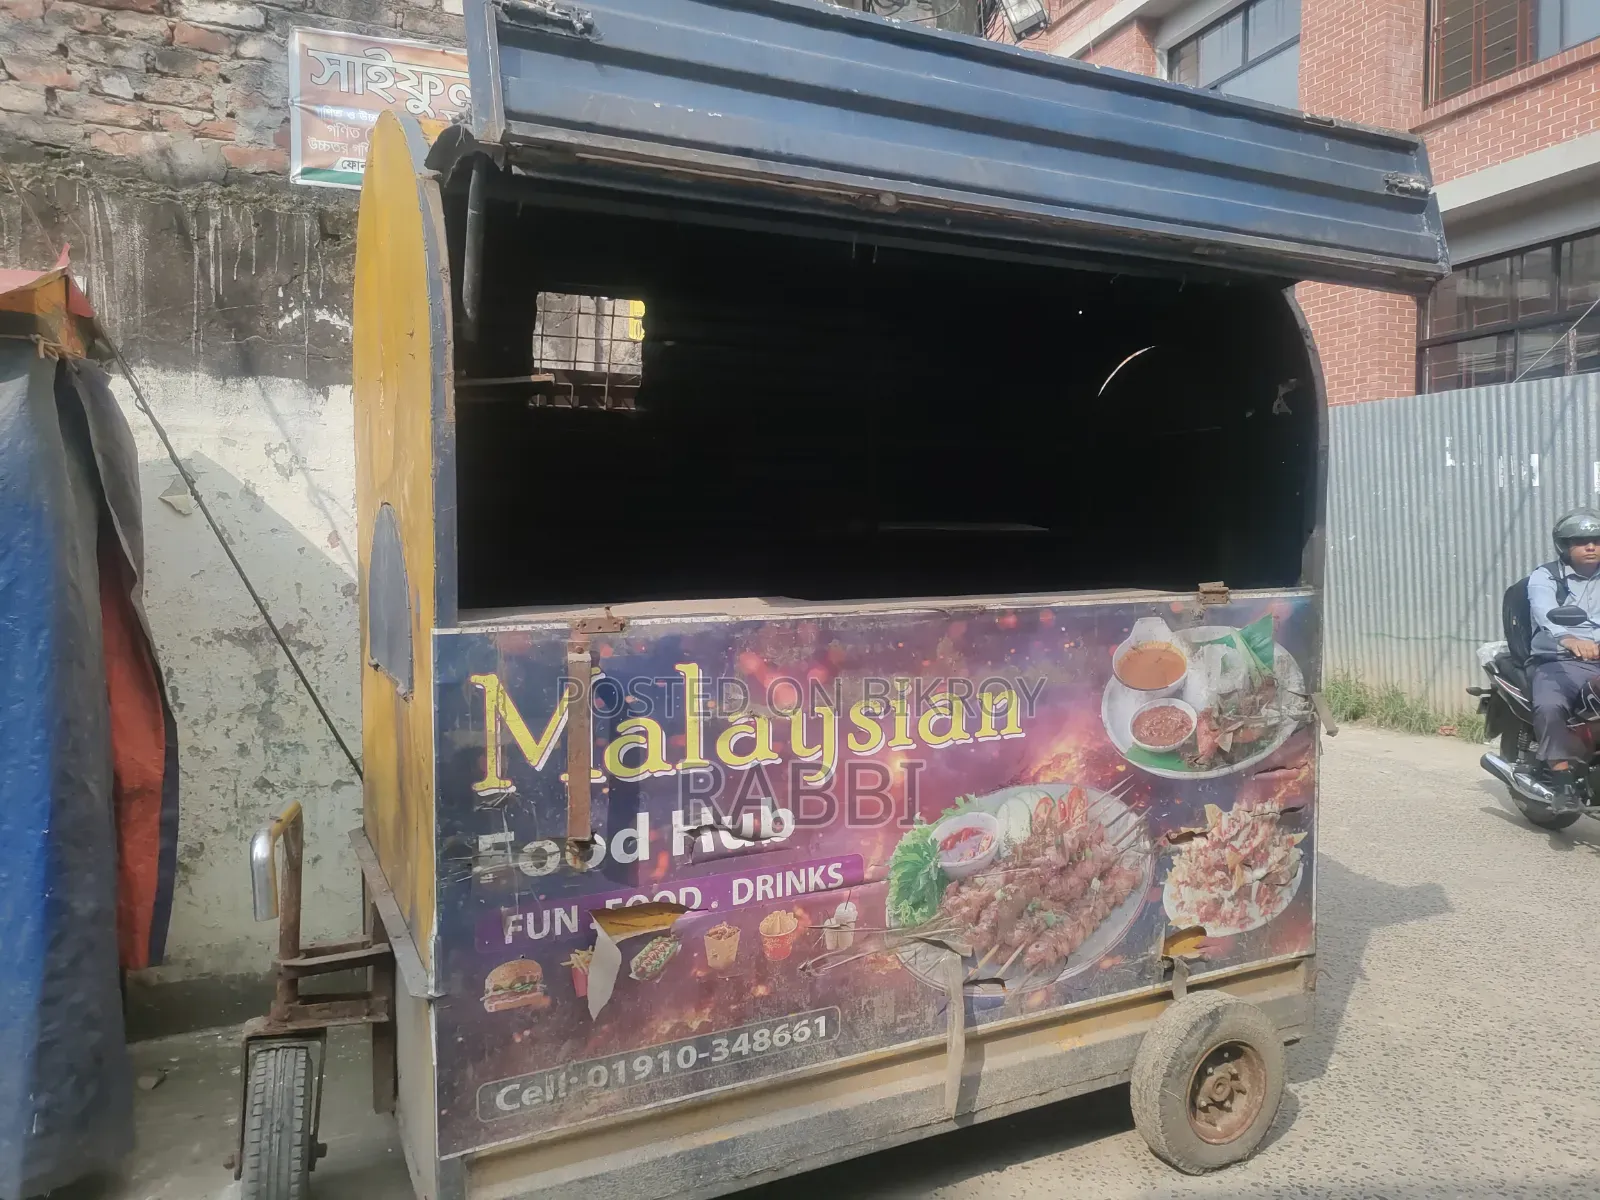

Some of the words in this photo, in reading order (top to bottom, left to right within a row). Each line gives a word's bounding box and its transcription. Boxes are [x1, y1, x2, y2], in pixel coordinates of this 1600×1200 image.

[307, 136, 349, 156] উচ্চতর
[326, 122, 361, 139] গণিত
[470, 662, 1025, 796] Malaysian
[477, 812, 650, 884] Food
[671, 797, 795, 856] Hub
[503, 905, 579, 944] FUN
[732, 862, 844, 906] DRINKS
